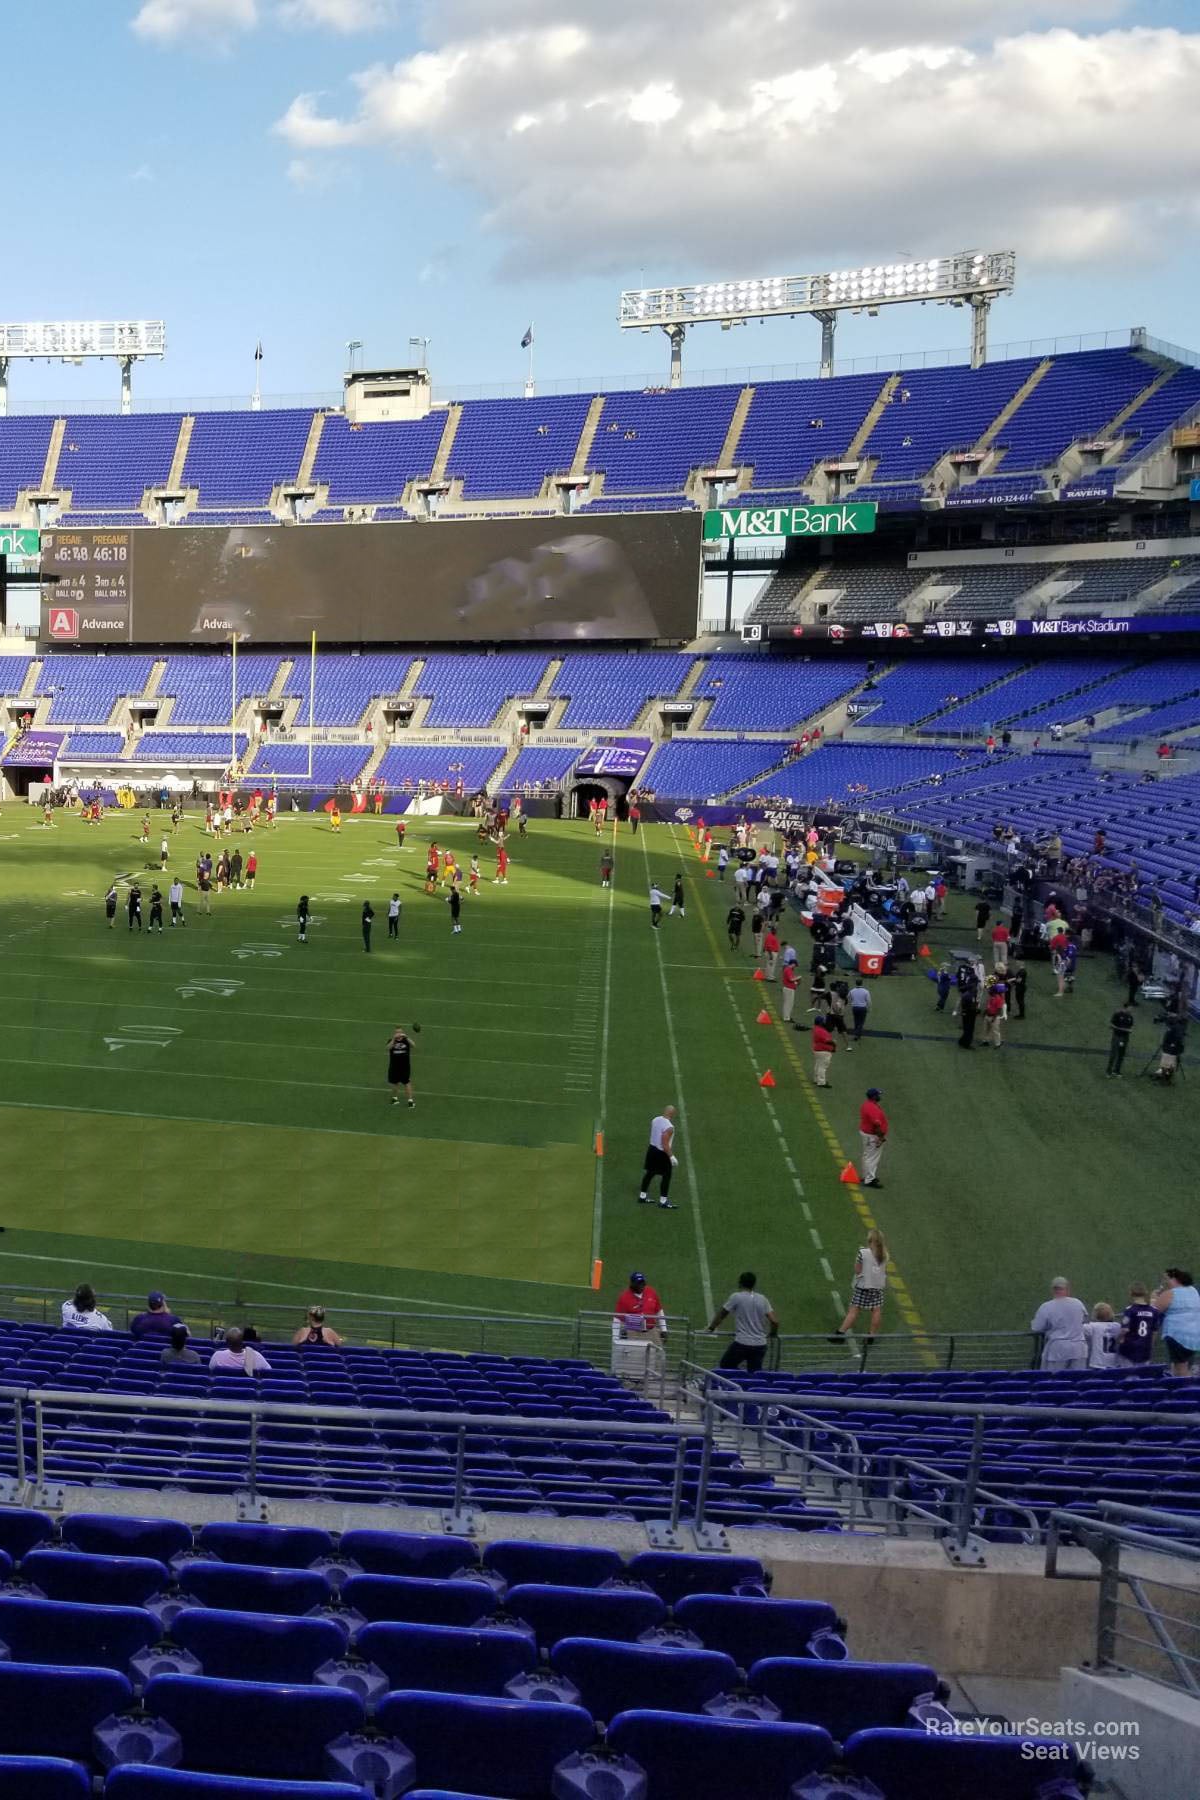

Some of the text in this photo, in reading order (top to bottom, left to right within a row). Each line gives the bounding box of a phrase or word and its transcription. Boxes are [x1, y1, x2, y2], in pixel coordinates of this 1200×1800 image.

[1066, 490, 1108, 498] RAVENS
[720, 506, 858, 537] M&T Bank
[92, 535, 128, 544] PREGAME
[94, 546, 127, 560] 46:18
[79, 574, 86, 586] 4
[94, 575, 110, 586] 3RD
[118, 574, 124, 586] 4
[94, 590, 108, 598] BALL
[119, 590, 126, 598] 25
[52, 612, 124, 632] A Advance
[1032, 620, 1129, 634] M&T Bank Stadium
[764, 810, 790, 819] PLAY
[770, 820, 804, 831] RAVE
[867, 958, 878, 969] G
[1138, 1320, 1148, 1336] 8
